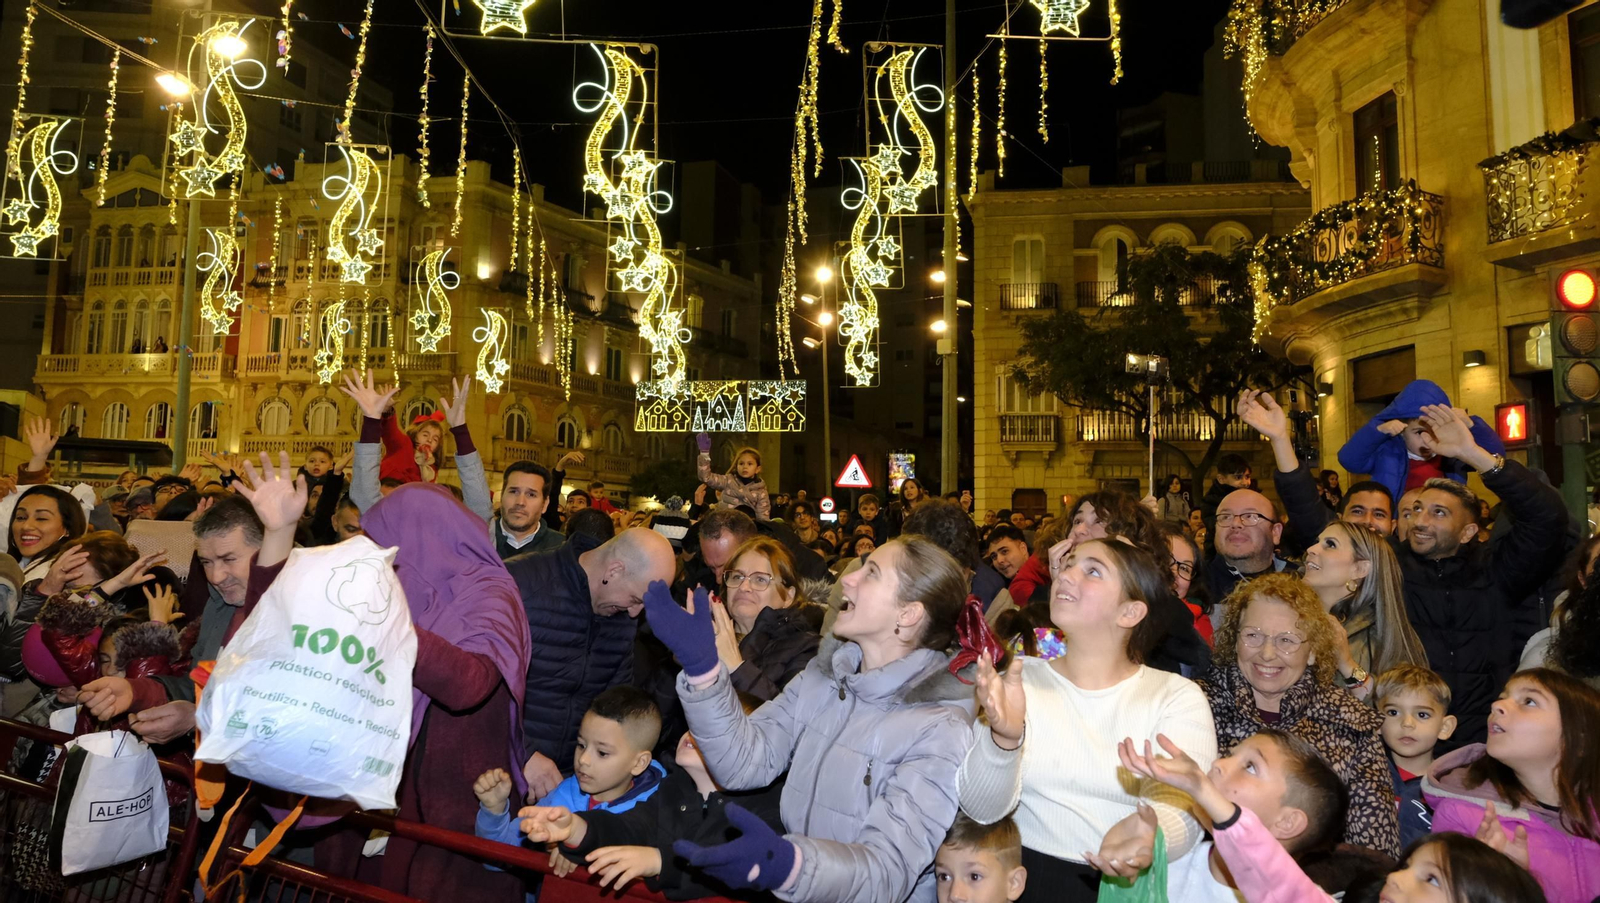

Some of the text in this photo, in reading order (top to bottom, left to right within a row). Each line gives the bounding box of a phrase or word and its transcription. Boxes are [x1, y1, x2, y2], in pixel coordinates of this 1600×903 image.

[292, 624, 386, 685] 100%
[243, 685, 298, 706] Reutiliza
[310, 702, 355, 724] Reduce
[335, 677, 395, 707] reciclado
[96, 795, 151, 817] ALE-HOP
